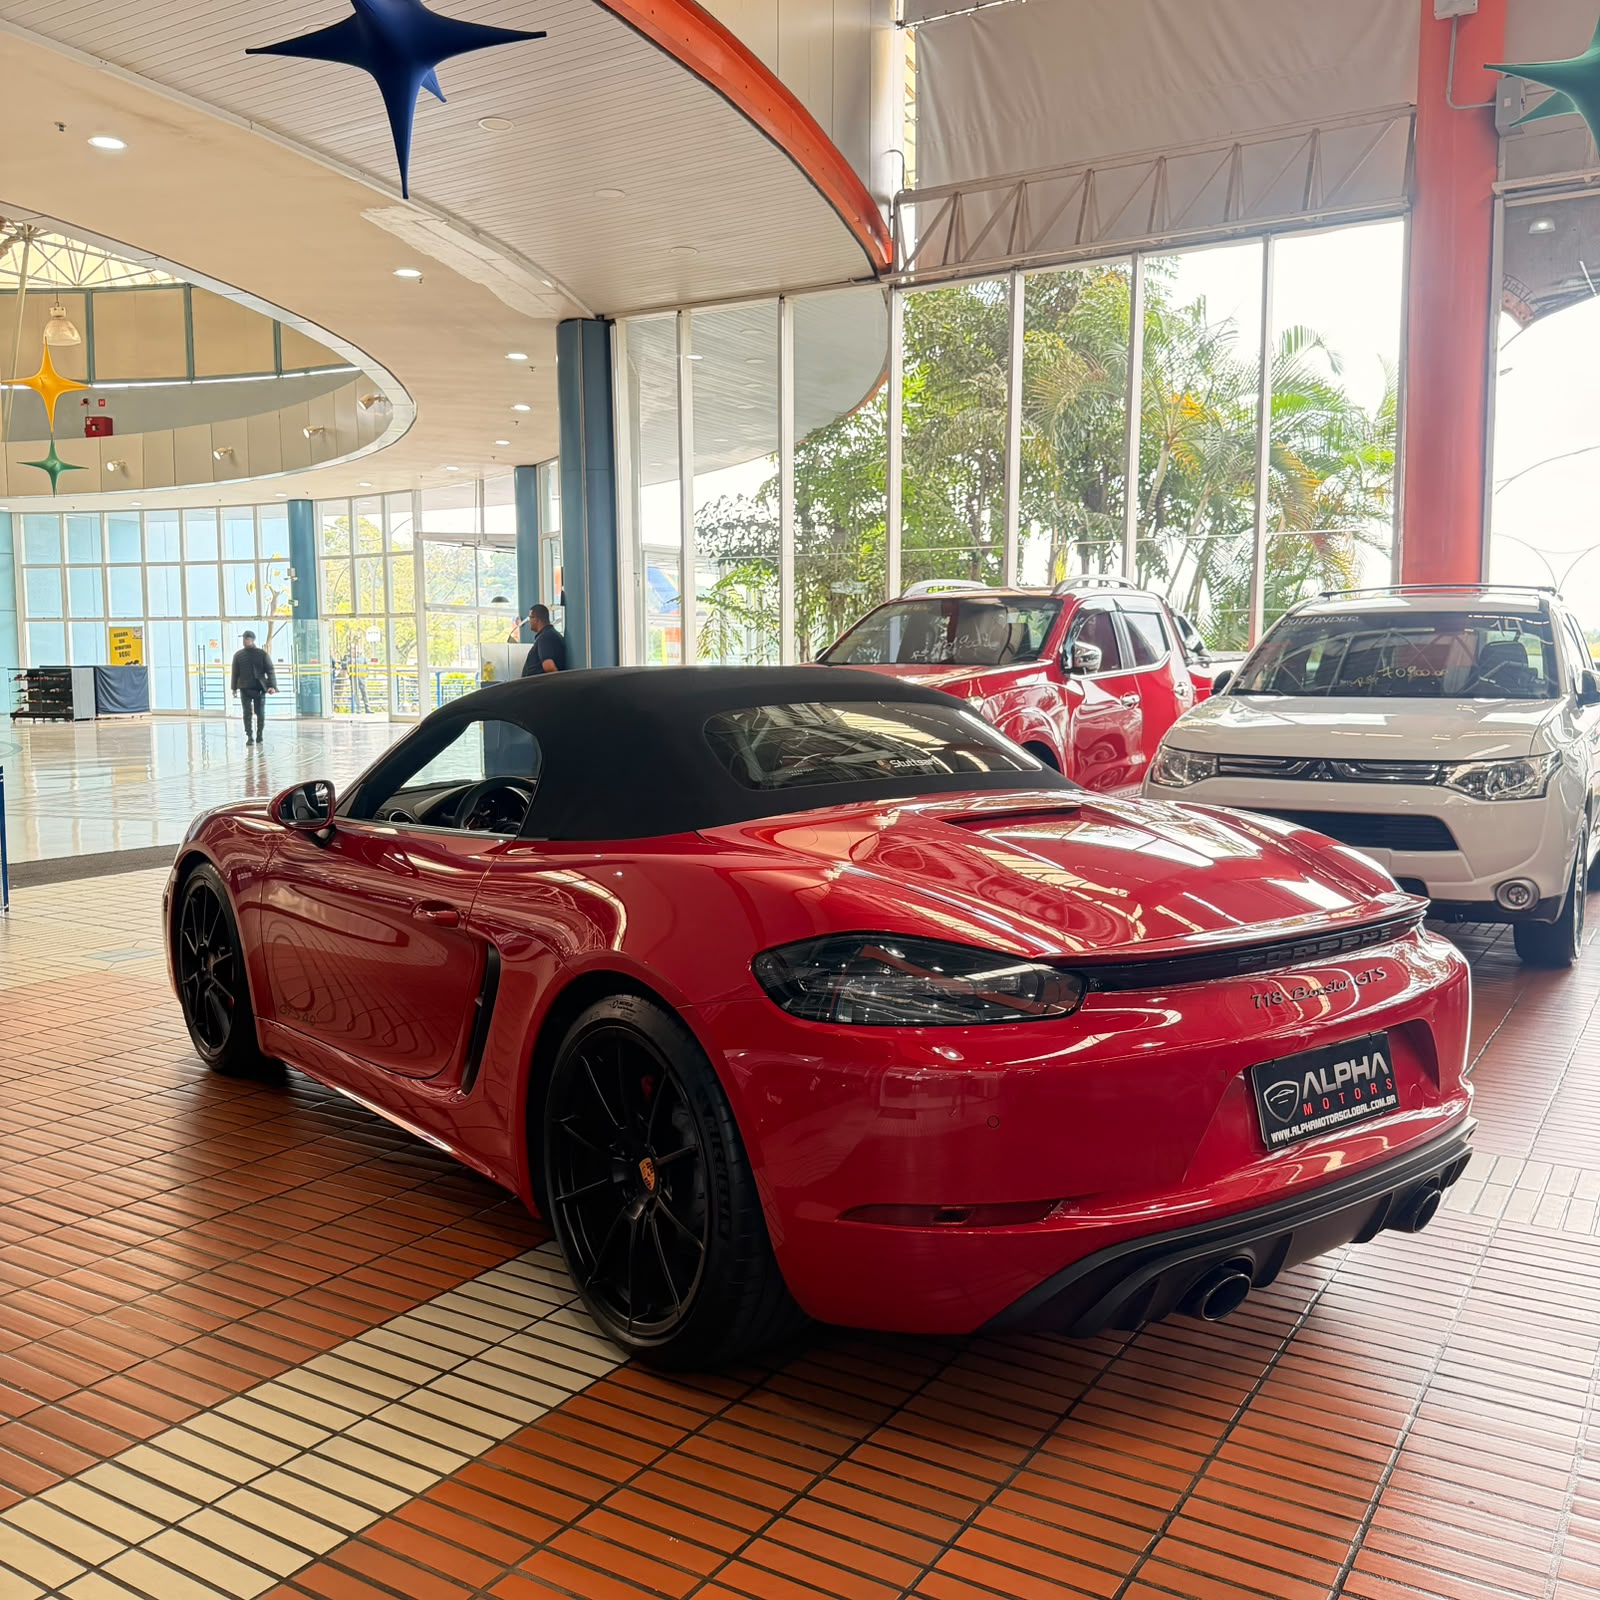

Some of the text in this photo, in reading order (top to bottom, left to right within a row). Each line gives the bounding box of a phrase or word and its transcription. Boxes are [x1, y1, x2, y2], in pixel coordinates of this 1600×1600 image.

[1237, 927, 1392, 966] PORSCHE
[1251, 966, 1388, 1009] 718 Boxster GTS
[1303, 1052, 1390, 1100] ALPHA
[1303, 1078, 1394, 1117] MOTORS
[1270, 1094, 1398, 1143] WWW.ALPHAMOTORSGLOBAL.COM.BR
